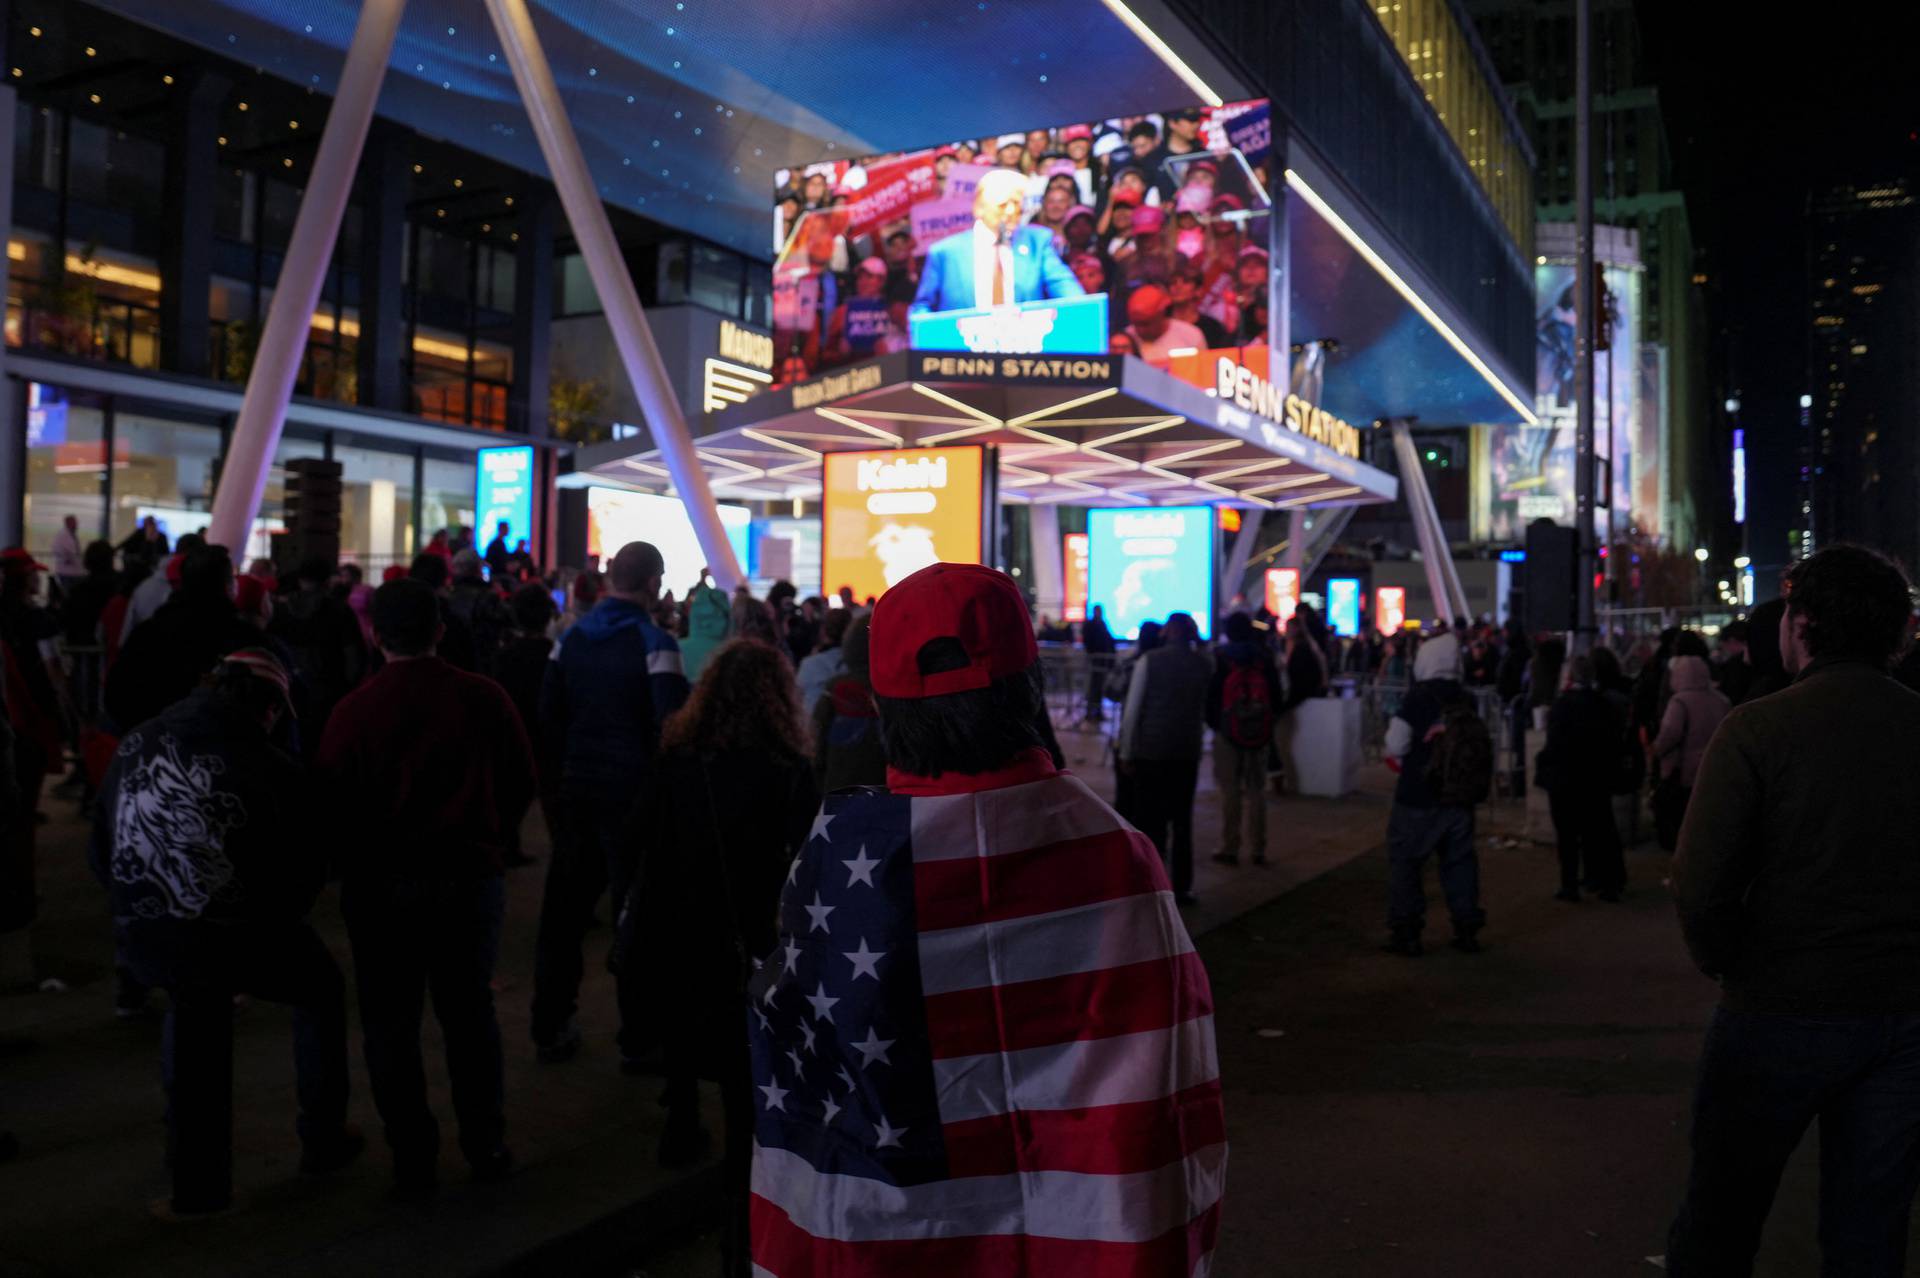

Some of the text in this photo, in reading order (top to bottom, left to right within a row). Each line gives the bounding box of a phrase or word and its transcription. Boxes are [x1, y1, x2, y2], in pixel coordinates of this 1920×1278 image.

[922, 357, 1110, 380] PENN STATION
[1218, 356, 1284, 425] PENN
[1285, 393, 1361, 460] STATION
